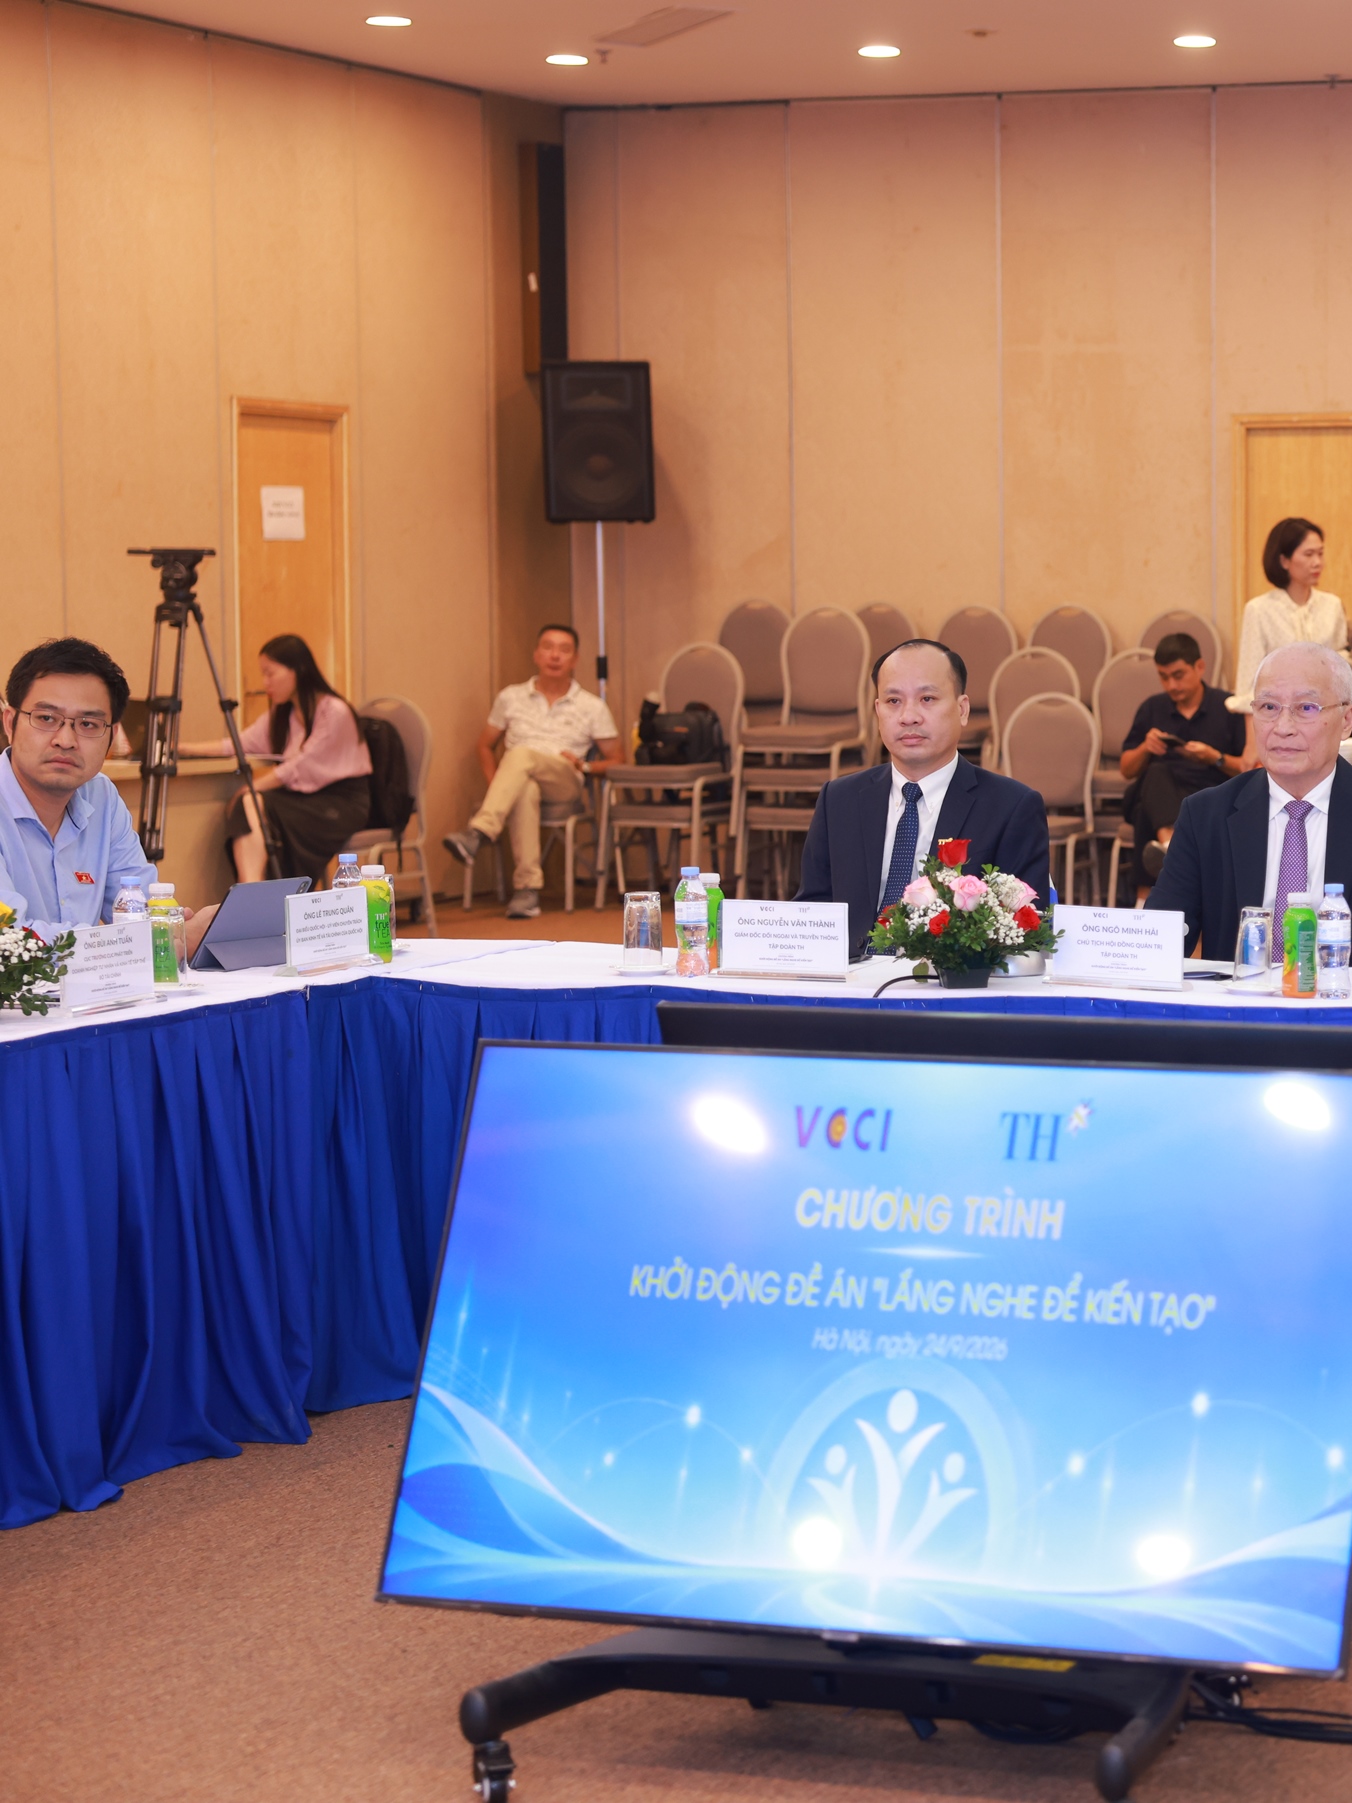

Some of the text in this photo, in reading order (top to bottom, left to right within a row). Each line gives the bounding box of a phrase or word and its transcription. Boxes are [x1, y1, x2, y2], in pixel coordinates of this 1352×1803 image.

[304, 905, 354, 920] ÔNG LÊ TRUNG QUÂN
[737, 917, 835, 928] ÔNG NGUYỄN VĂN THÀNH
[97, 939, 106, 948] BÙI
[118, 935, 132, 944] TUẤN
[1082, 924, 1158, 936] ÔNG NGÔ MINH HẢI
[1105, 940, 1116, 948] HỘI
[1117, 940, 1135, 948] ĐỒNG
[1135, 941, 1153, 950] QUẢN
[794, 1105, 893, 1153] VCCI
[1000, 1111, 1065, 1163] TH
[795, 1185, 1065, 1240] CHƯƠNG TRÌNH
[629, 1256, 694, 1300] KHỞI
[696, 1262, 781, 1310] ĐỘNG
[785, 1261, 823, 1307] ĐỀ
[824, 1267, 868, 1309] ÁN
[960, 1281, 1039, 1320] NGHE
[1041, 1271, 1083, 1322] ĐỂ
[1084, 1278, 1144, 1326] KIẾN
[811, 1326, 839, 1351] Hà
[875, 1331, 922, 1359] ngày
